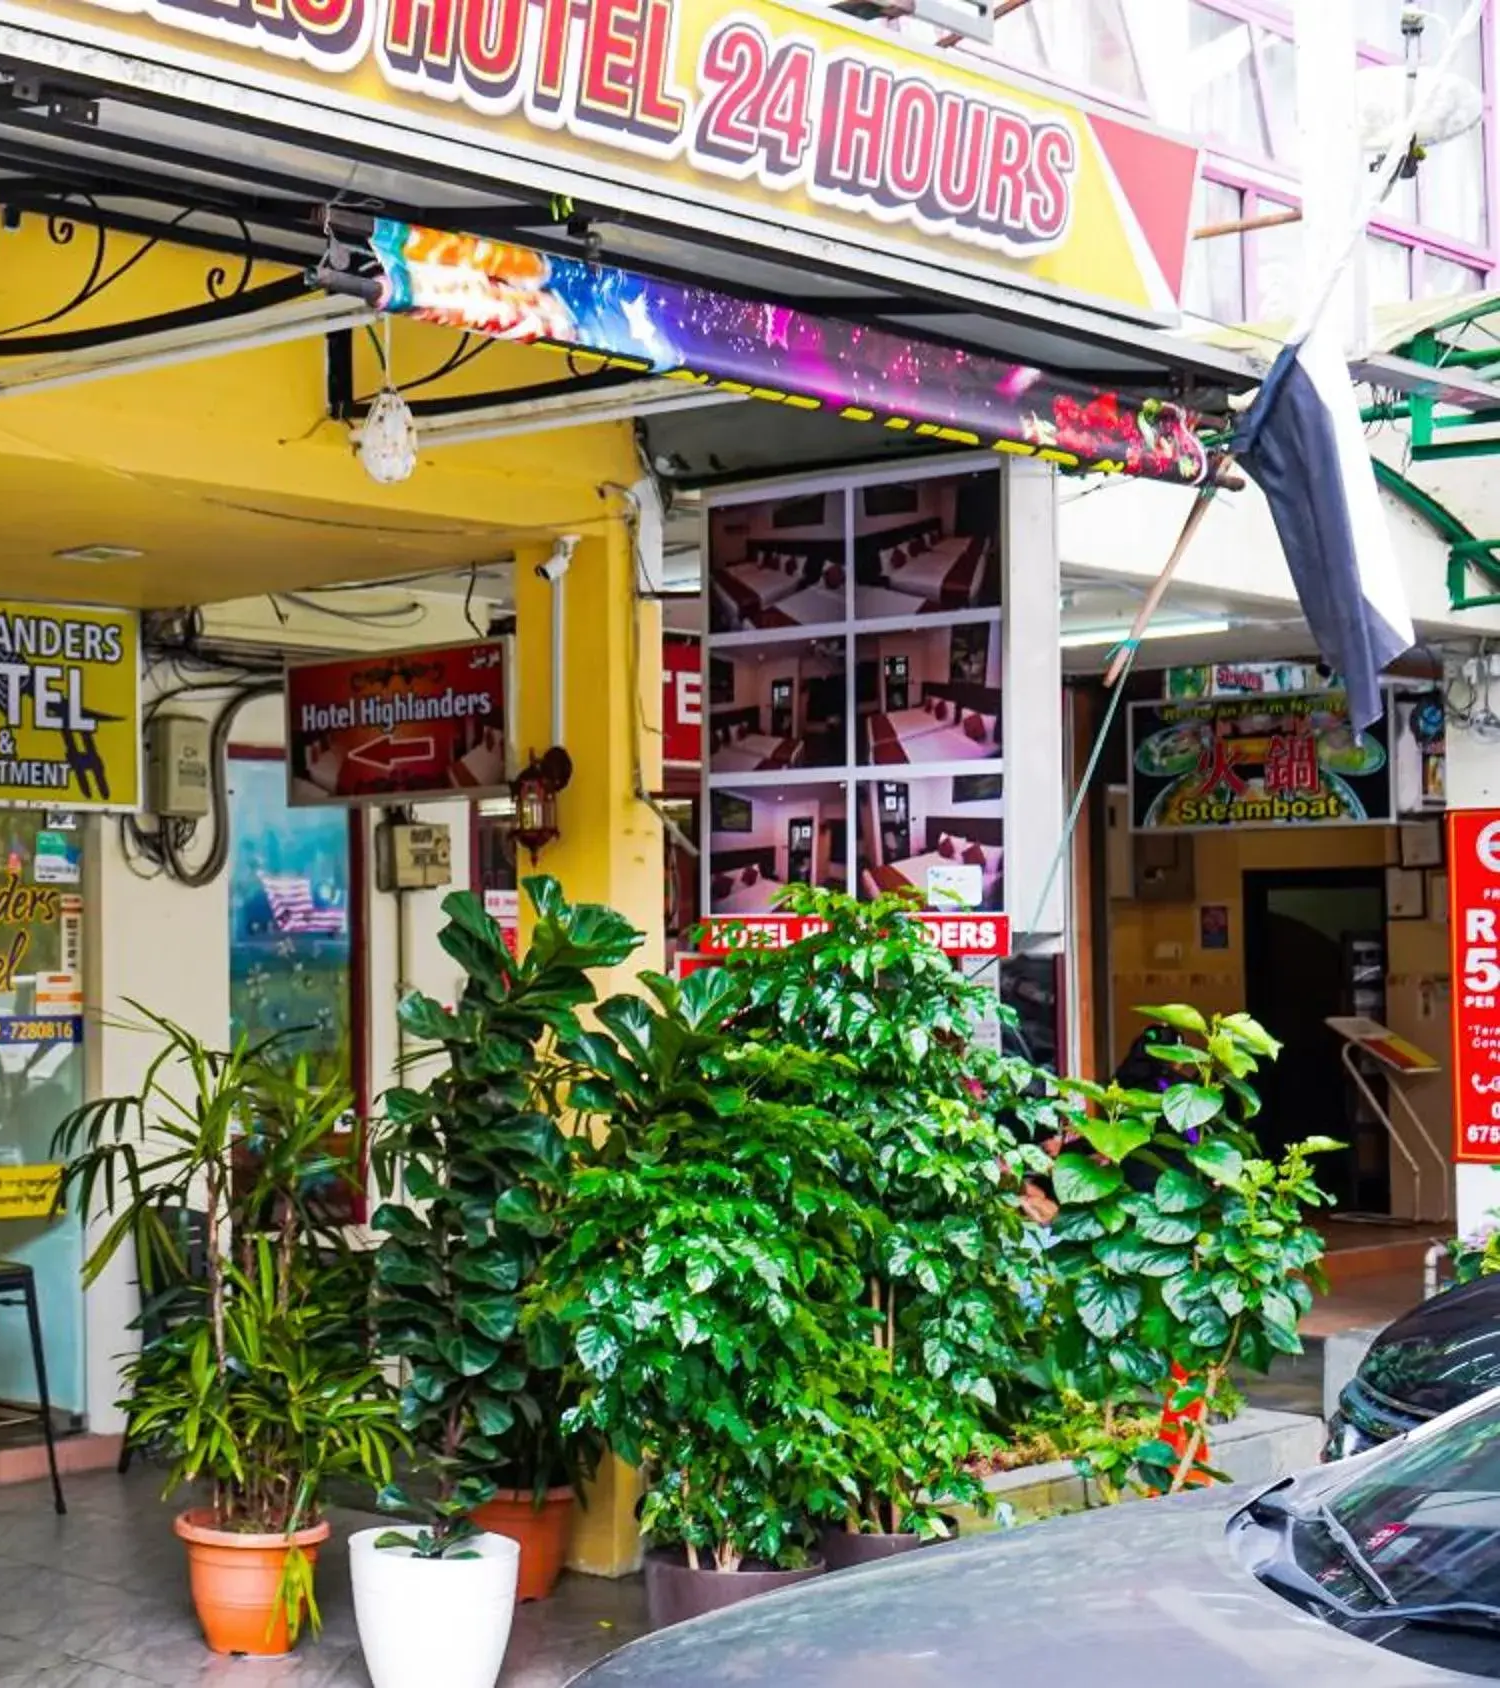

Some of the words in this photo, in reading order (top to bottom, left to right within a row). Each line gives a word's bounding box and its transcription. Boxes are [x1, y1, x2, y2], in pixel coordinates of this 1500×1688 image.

[700, 25, 813, 168] 24
[825, 60, 1073, 240] HOURS
[302, 698, 356, 732] Hotel
[360, 687, 493, 730] Highlanders
[1181, 797, 1340, 822] Steamboat
[1464, 995, 1496, 1009] PER
